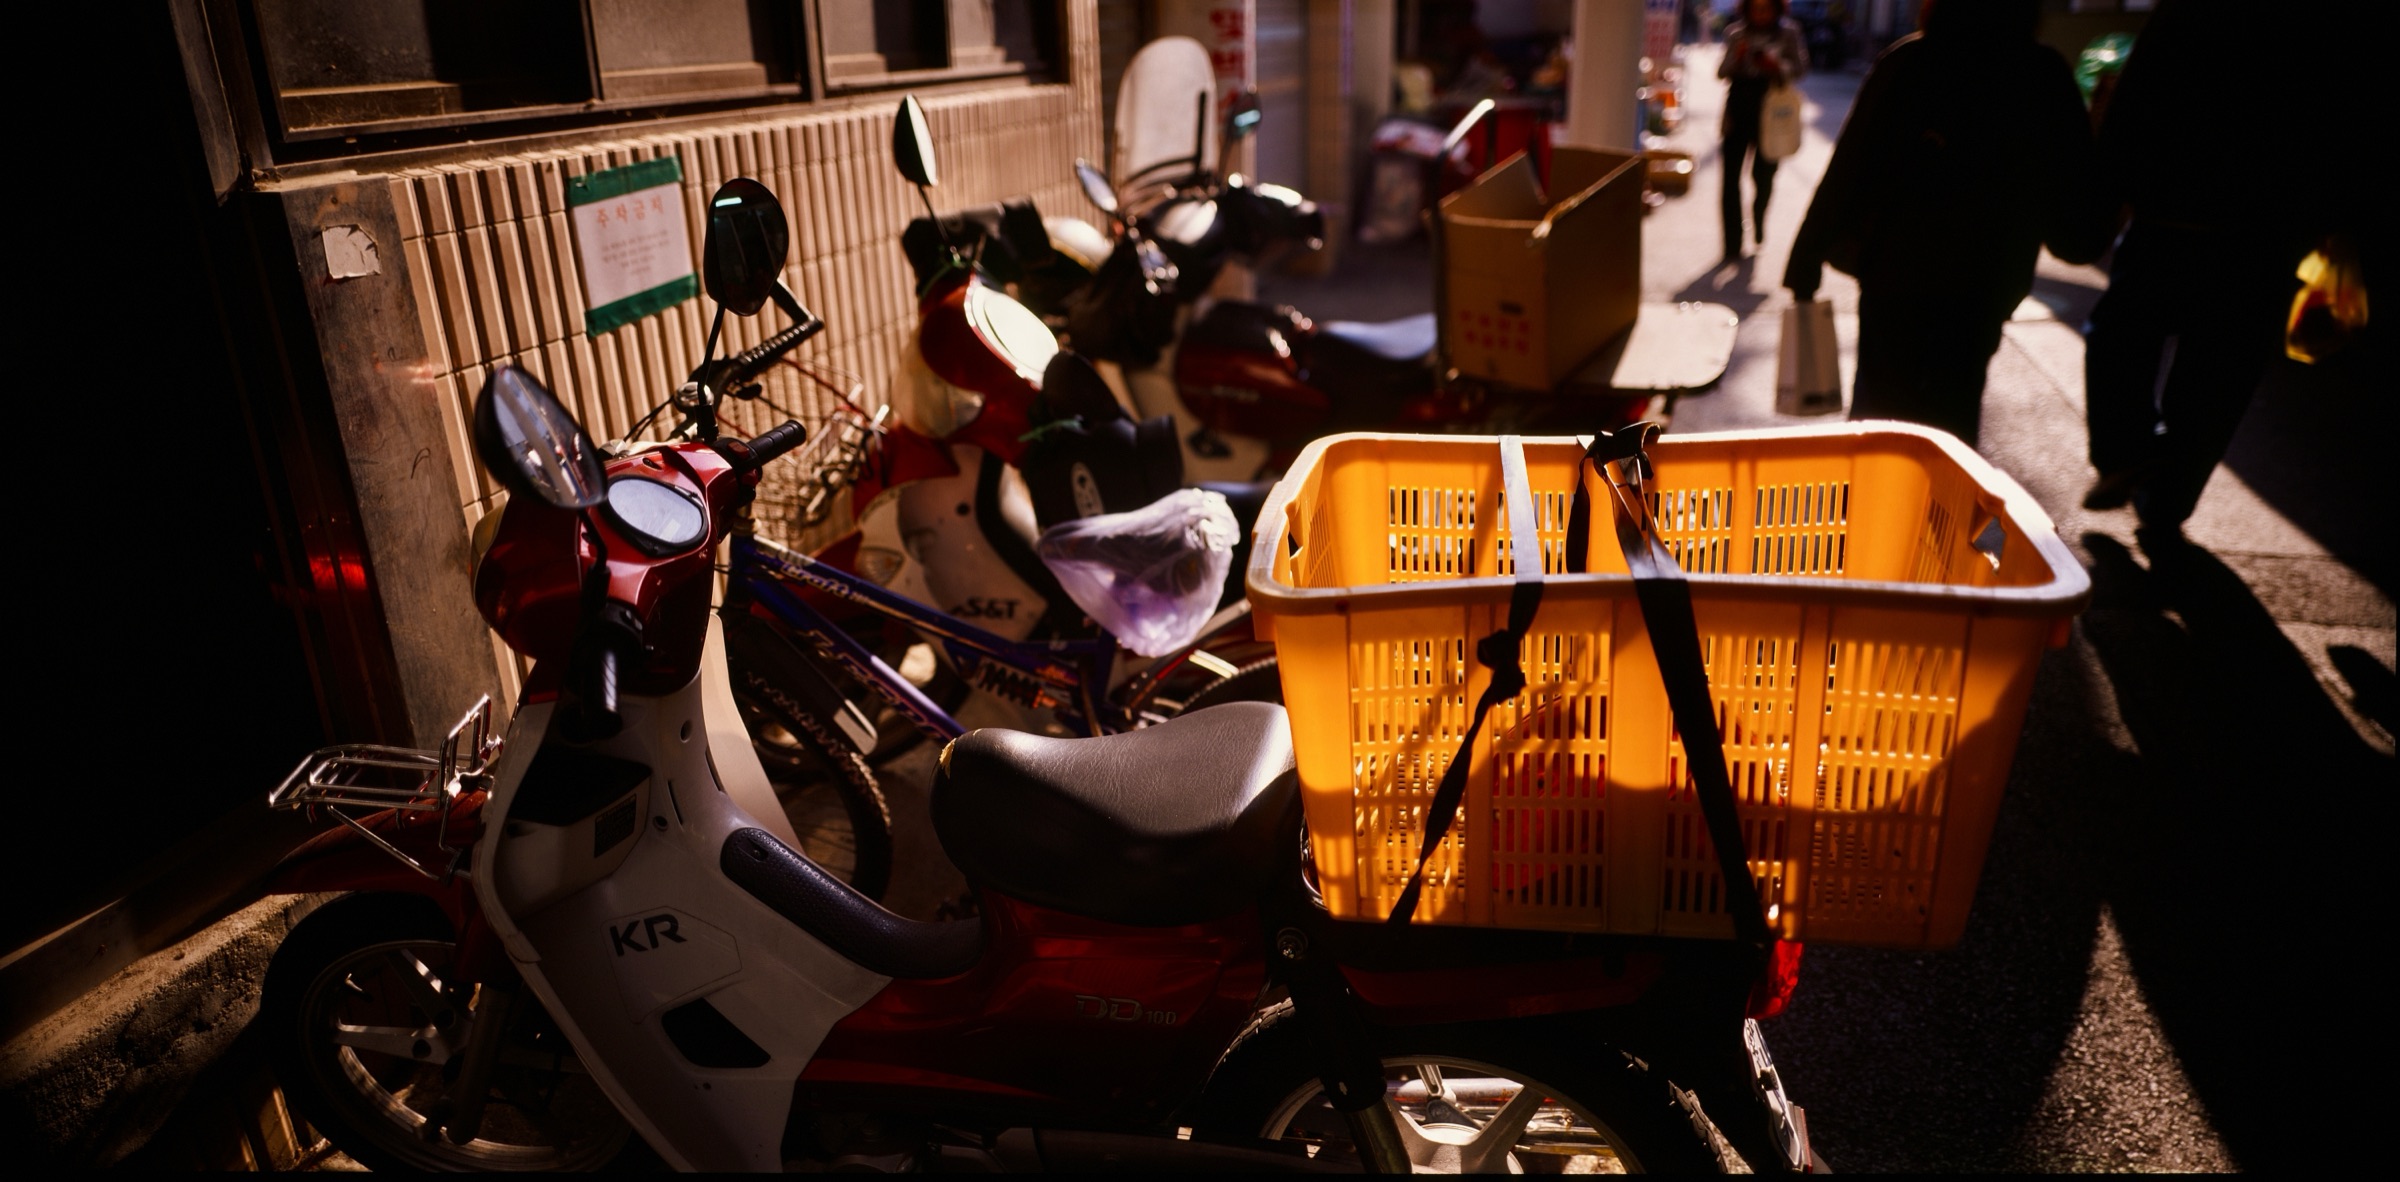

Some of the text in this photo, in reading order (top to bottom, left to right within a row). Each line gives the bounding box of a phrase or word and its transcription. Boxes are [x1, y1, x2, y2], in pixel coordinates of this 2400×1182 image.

[961, 597, 1018, 618] S&T
[610, 914, 687, 957] KR
[1075, 994, 1177, 1025] DD 100
